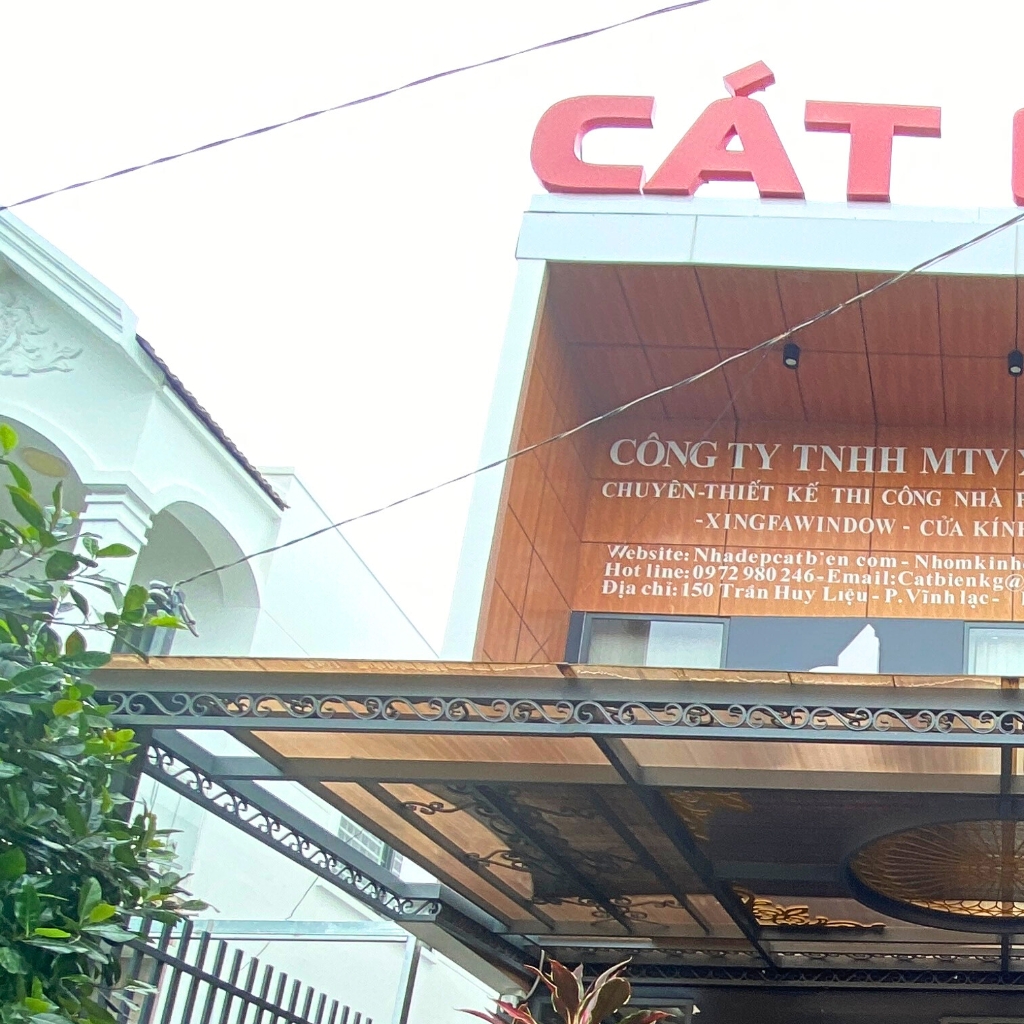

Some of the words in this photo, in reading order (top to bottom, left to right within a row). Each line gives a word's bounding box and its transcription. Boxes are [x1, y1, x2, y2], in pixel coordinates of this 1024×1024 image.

[530, 60, 942, 202] CÁT
[610, 432, 718, 469] CÔNG
[728, 442, 782, 471] TY
[793, 444, 908, 474] TNHH
[920, 447, 1010, 476] MTV
[787, 482, 819, 503] KẾ
[832, 487, 872, 504] THI
[881, 485, 942, 507] CÔNG
[955, 487, 1003, 508] NHÀ
[920, 515, 964, 537] CỬA
[602, 580, 637, 599] Địa
[682, 582, 714, 598] 150
[774, 585, 816, 605] Huy
